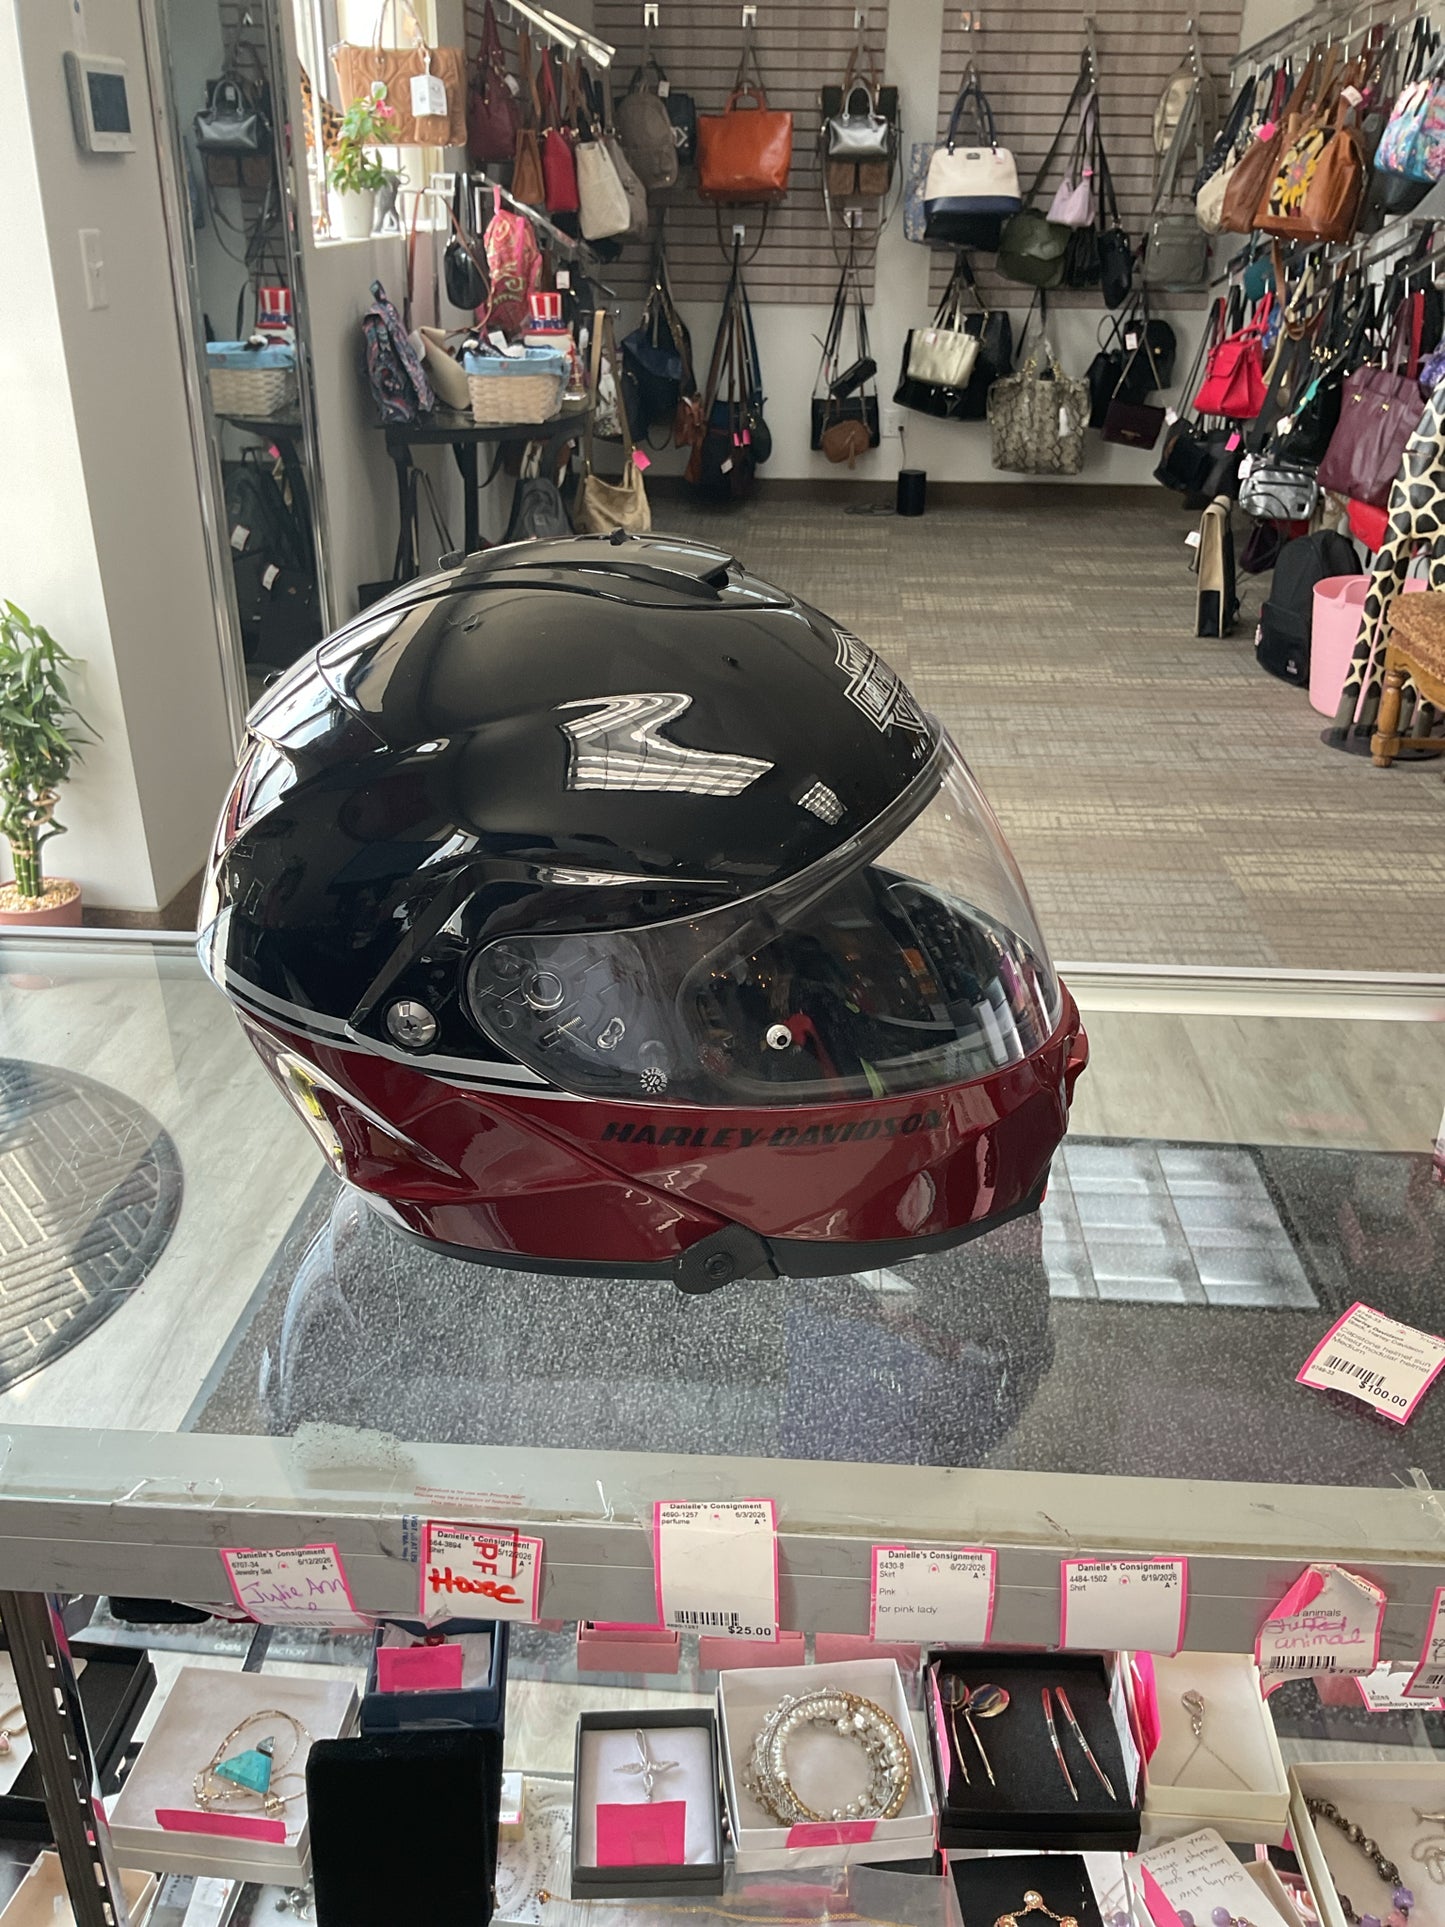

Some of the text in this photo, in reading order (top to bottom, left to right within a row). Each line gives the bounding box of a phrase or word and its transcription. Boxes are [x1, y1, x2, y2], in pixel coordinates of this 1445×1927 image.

[600, 1109, 945, 1147] HARLEY-DAVIDSON
[1358, 1380, 1408, 1408] $100.00
[710, 1503, 762, 1511] Consignment
[437, 1530, 530, 1550] Danielle's Consignment
[237, 1548, 326, 1559] Danielle's Consignment
[888, 1550, 983, 1561] Danielle's Consignment
[1077, 1562, 1174, 1572] Danielle's Consignment
[879, 1587, 896, 1596] Pink
[1069, 1584, 1087, 1592] Shirt
[878, 1604, 938, 1615] for pink lady
[1302, 1608, 1341, 1617] animals
[728, 1625, 772, 1636] $25.00
